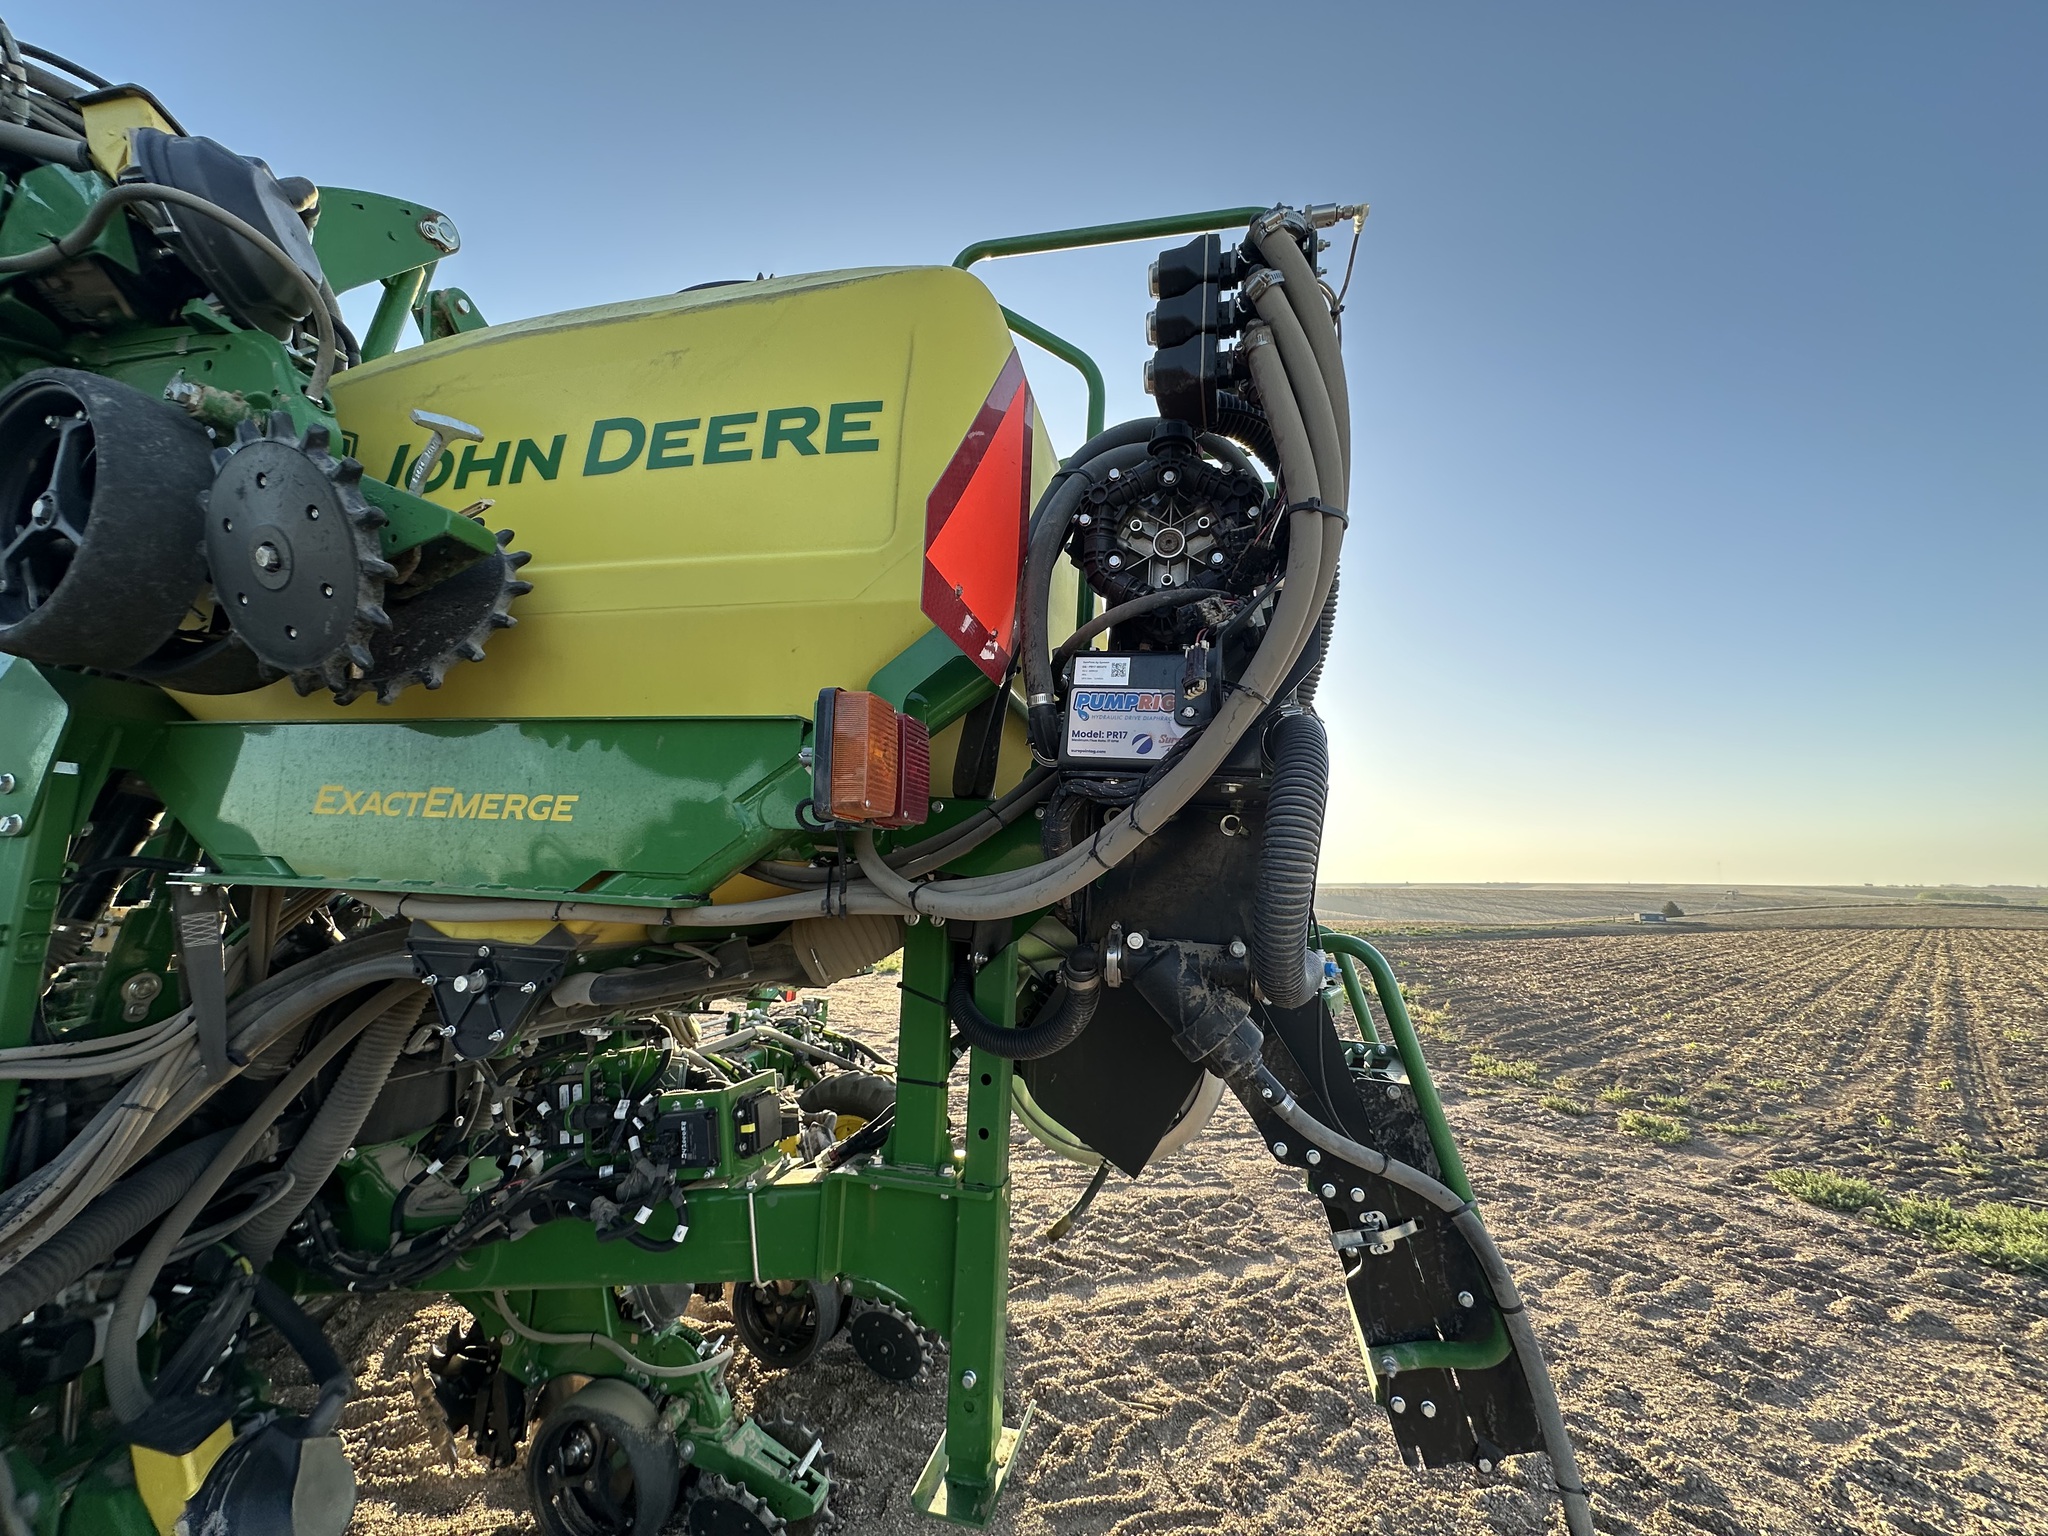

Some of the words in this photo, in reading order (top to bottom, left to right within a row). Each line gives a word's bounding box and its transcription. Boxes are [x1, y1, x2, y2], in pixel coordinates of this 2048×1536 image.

[582, 400, 883, 477] DEERE
[1074, 692, 1175, 712] PUMPRIG
[1071, 730, 1104, 739] Model:
[1106, 731, 1128, 739] PR17
